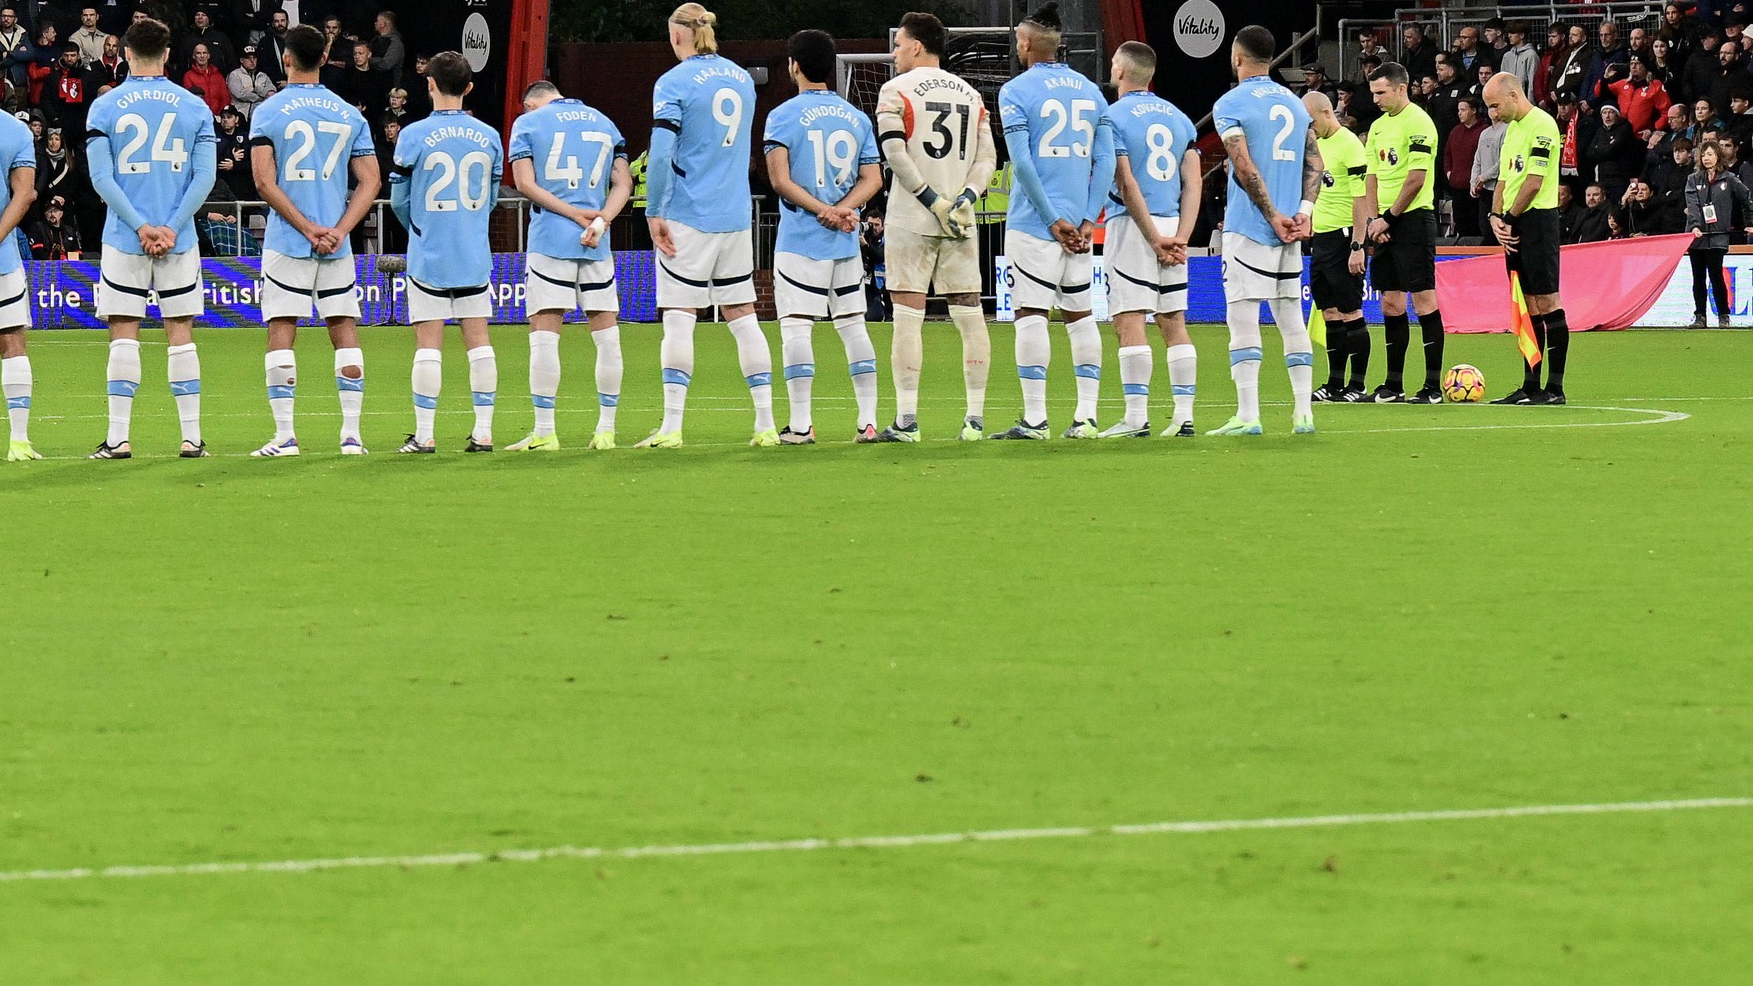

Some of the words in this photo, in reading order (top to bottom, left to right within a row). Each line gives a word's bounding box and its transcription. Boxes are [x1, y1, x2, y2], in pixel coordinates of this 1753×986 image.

[465, 30, 488, 55] Vitality
[1179, 15, 1220, 41] Vitality
[693, 68, 746, 85] HAALAND
[914, 78, 964, 97] EDERSON
[1044, 76, 1083, 91] AKANJI
[117, 89, 182, 109] GVARDIOL
[281, 97, 339, 116] MATHEUS
[556, 111, 597, 124] FODEN
[711, 87, 743, 147] 9
[115, 112, 188, 174] 24
[424, 126, 489, 148] BERNARDO
[922, 101, 971, 161] 31
[1038, 98, 1098, 158] 25
[1269, 104, 1296, 162] 2
[283, 119, 353, 182] 27
[545, 131, 613, 189] 47
[808, 129, 858, 188] 19
[1145, 123, 1188, 182] 8
[423, 151, 492, 212] 20
[38, 283, 81, 308] the
